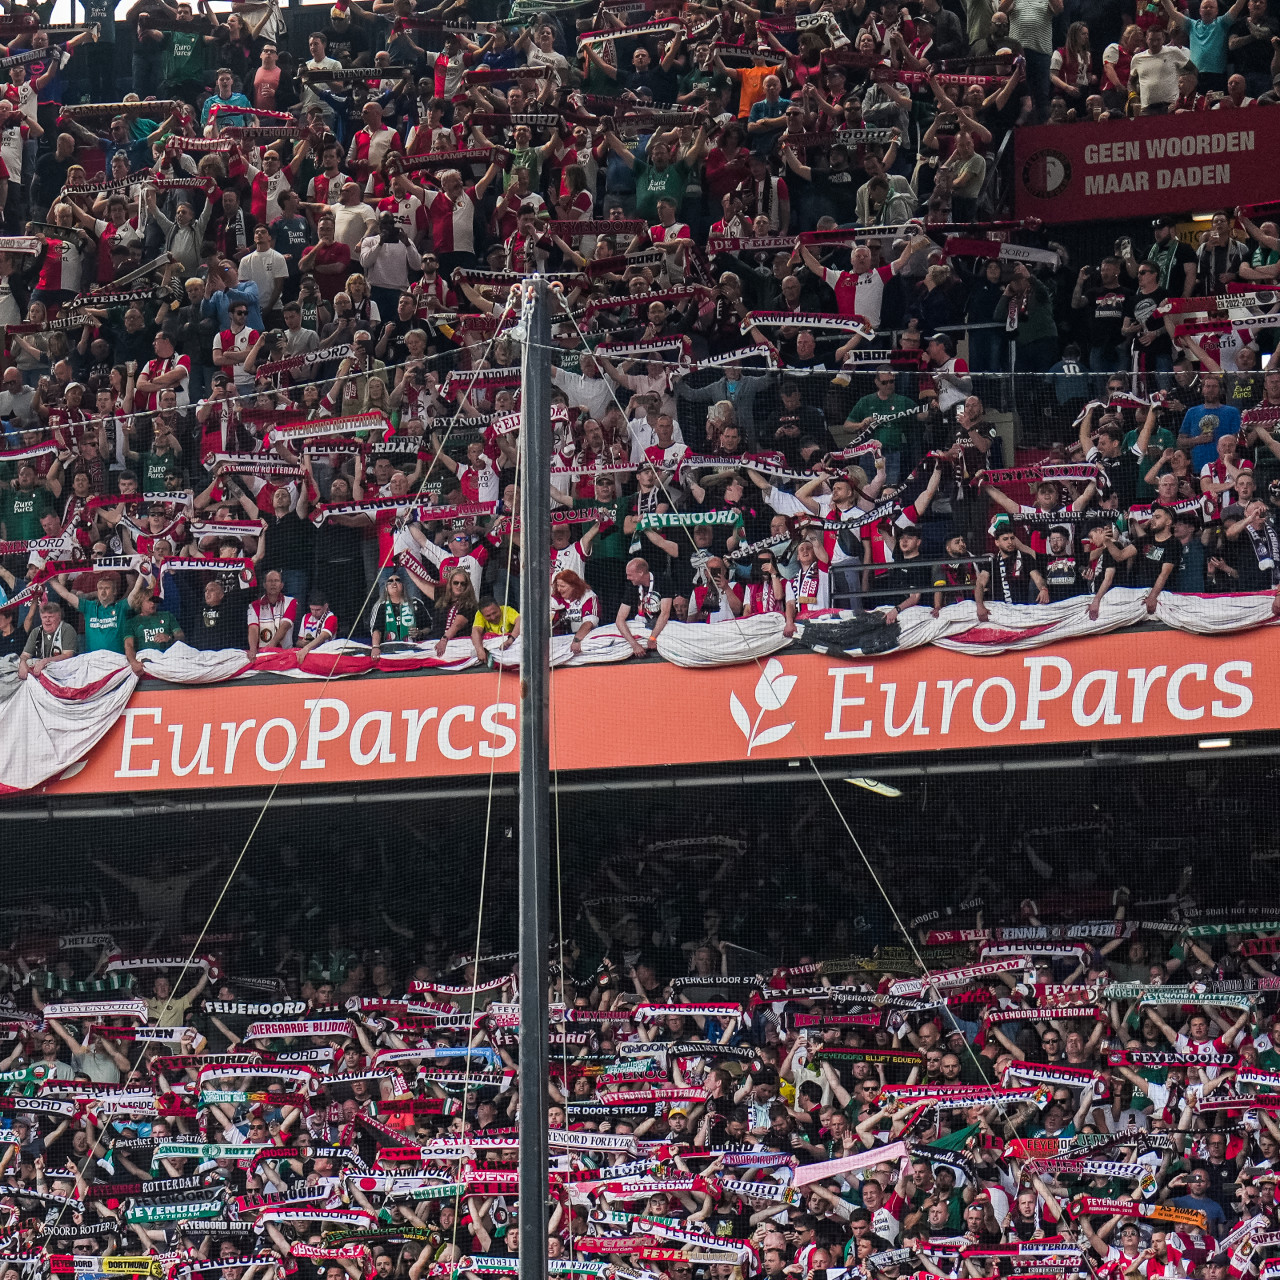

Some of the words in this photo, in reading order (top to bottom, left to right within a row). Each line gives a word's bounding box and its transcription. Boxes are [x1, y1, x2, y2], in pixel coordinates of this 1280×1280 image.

[1084, 141, 1139, 165] GEEN
[1147, 130, 1255, 160] WOORDEN
[1084, 171, 1149, 196] MAAR
[1157, 164, 1231, 189] DADEN
[640, 511, 738, 527] FEYENOORD
[824, 655, 1254, 741] EuroParcs
[114, 697, 517, 779] EuroParcs
[58, 1003, 143, 1015] FEYENOORD
[206, 1001, 307, 1015] FEIJENOORD
[990, 1009, 1038, 1020] FEYENOORD
[1040, 1008, 1094, 1018] ROTTERDAM
[1132, 1052, 1235, 1066] FEYENOORD
[603, 1092, 651, 1104] FEYENOORD
[654, 1089, 707, 1102] ROTTERDAM
[584, 1106, 609, 1116] DOOR
[612, 1105, 647, 1116] STRIJD
[596, 1134, 632, 1148] FOREVER
[142, 1177, 200, 1191] ROTTERDAM
[128, 1203, 222, 1218] FEYENOORD
[148, 1212, 201, 1221] ROTTERDAM
[1160, 1206, 1173, 1216] AS
[1175, 1206, 1200, 1218] ROMA
[107, 1258, 150, 1271] DORTMUND
